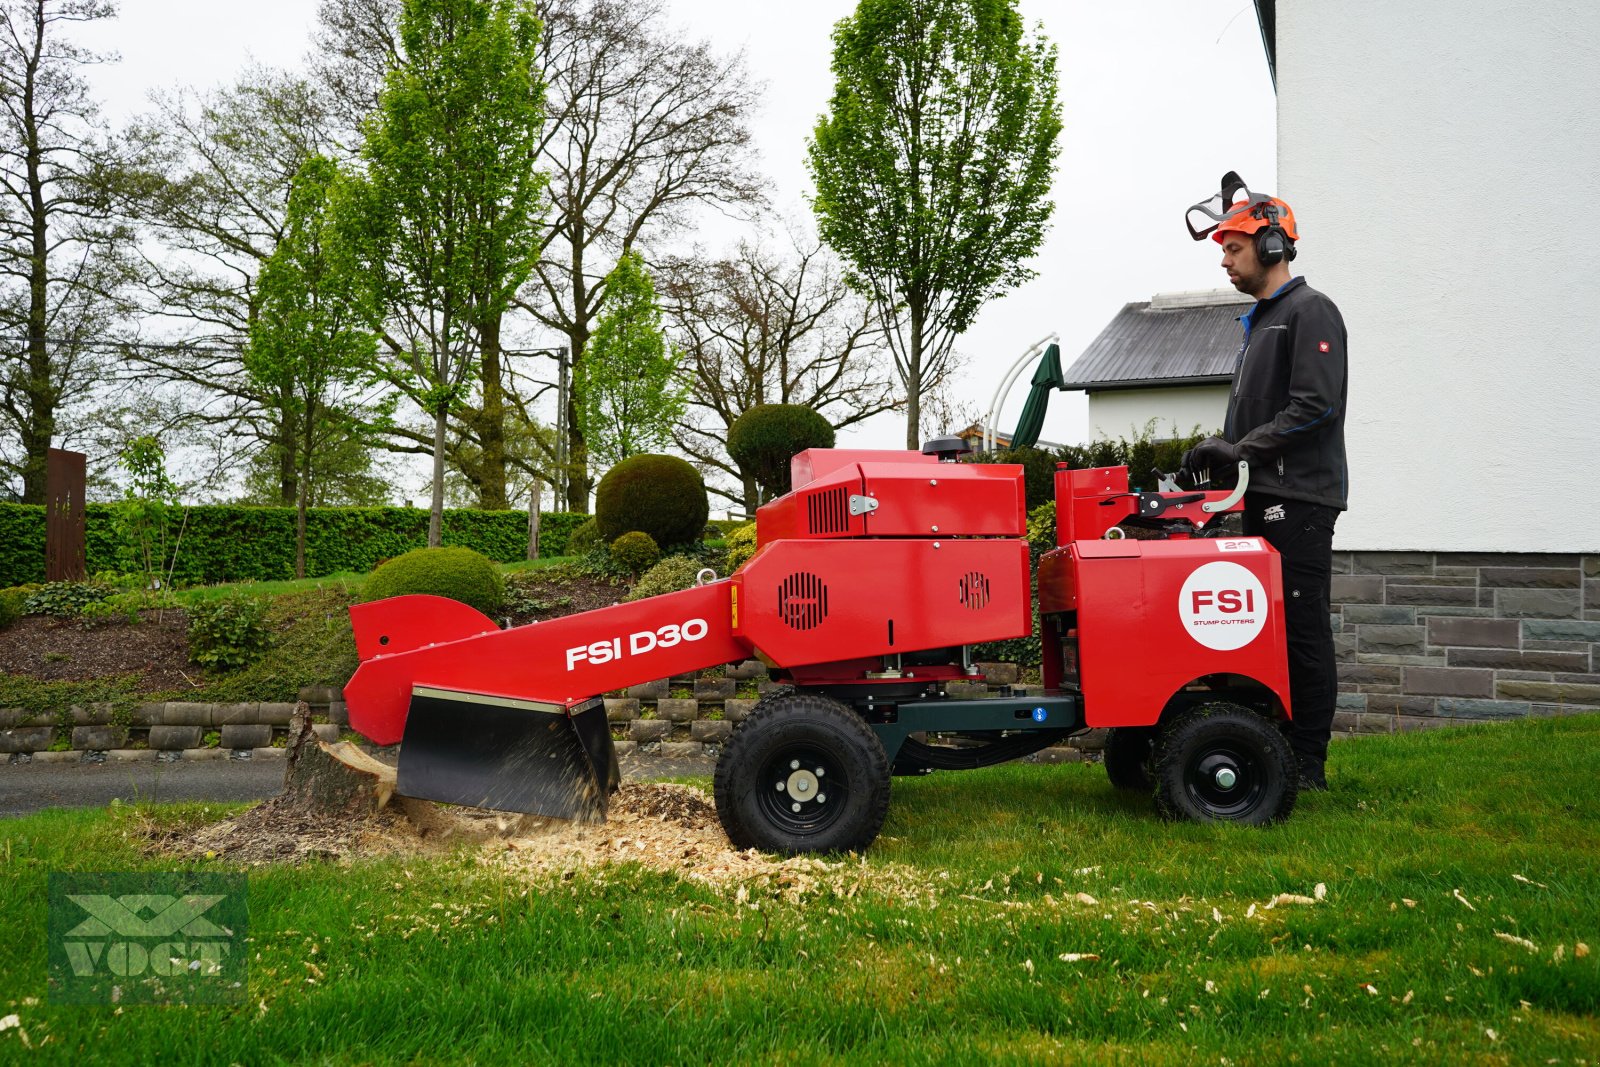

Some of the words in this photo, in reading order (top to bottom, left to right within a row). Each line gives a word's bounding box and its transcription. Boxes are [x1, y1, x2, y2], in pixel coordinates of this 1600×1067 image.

[1192, 589, 1254, 614] FSI
[566, 637, 622, 671] FSI
[629, 618, 709, 656] D30
